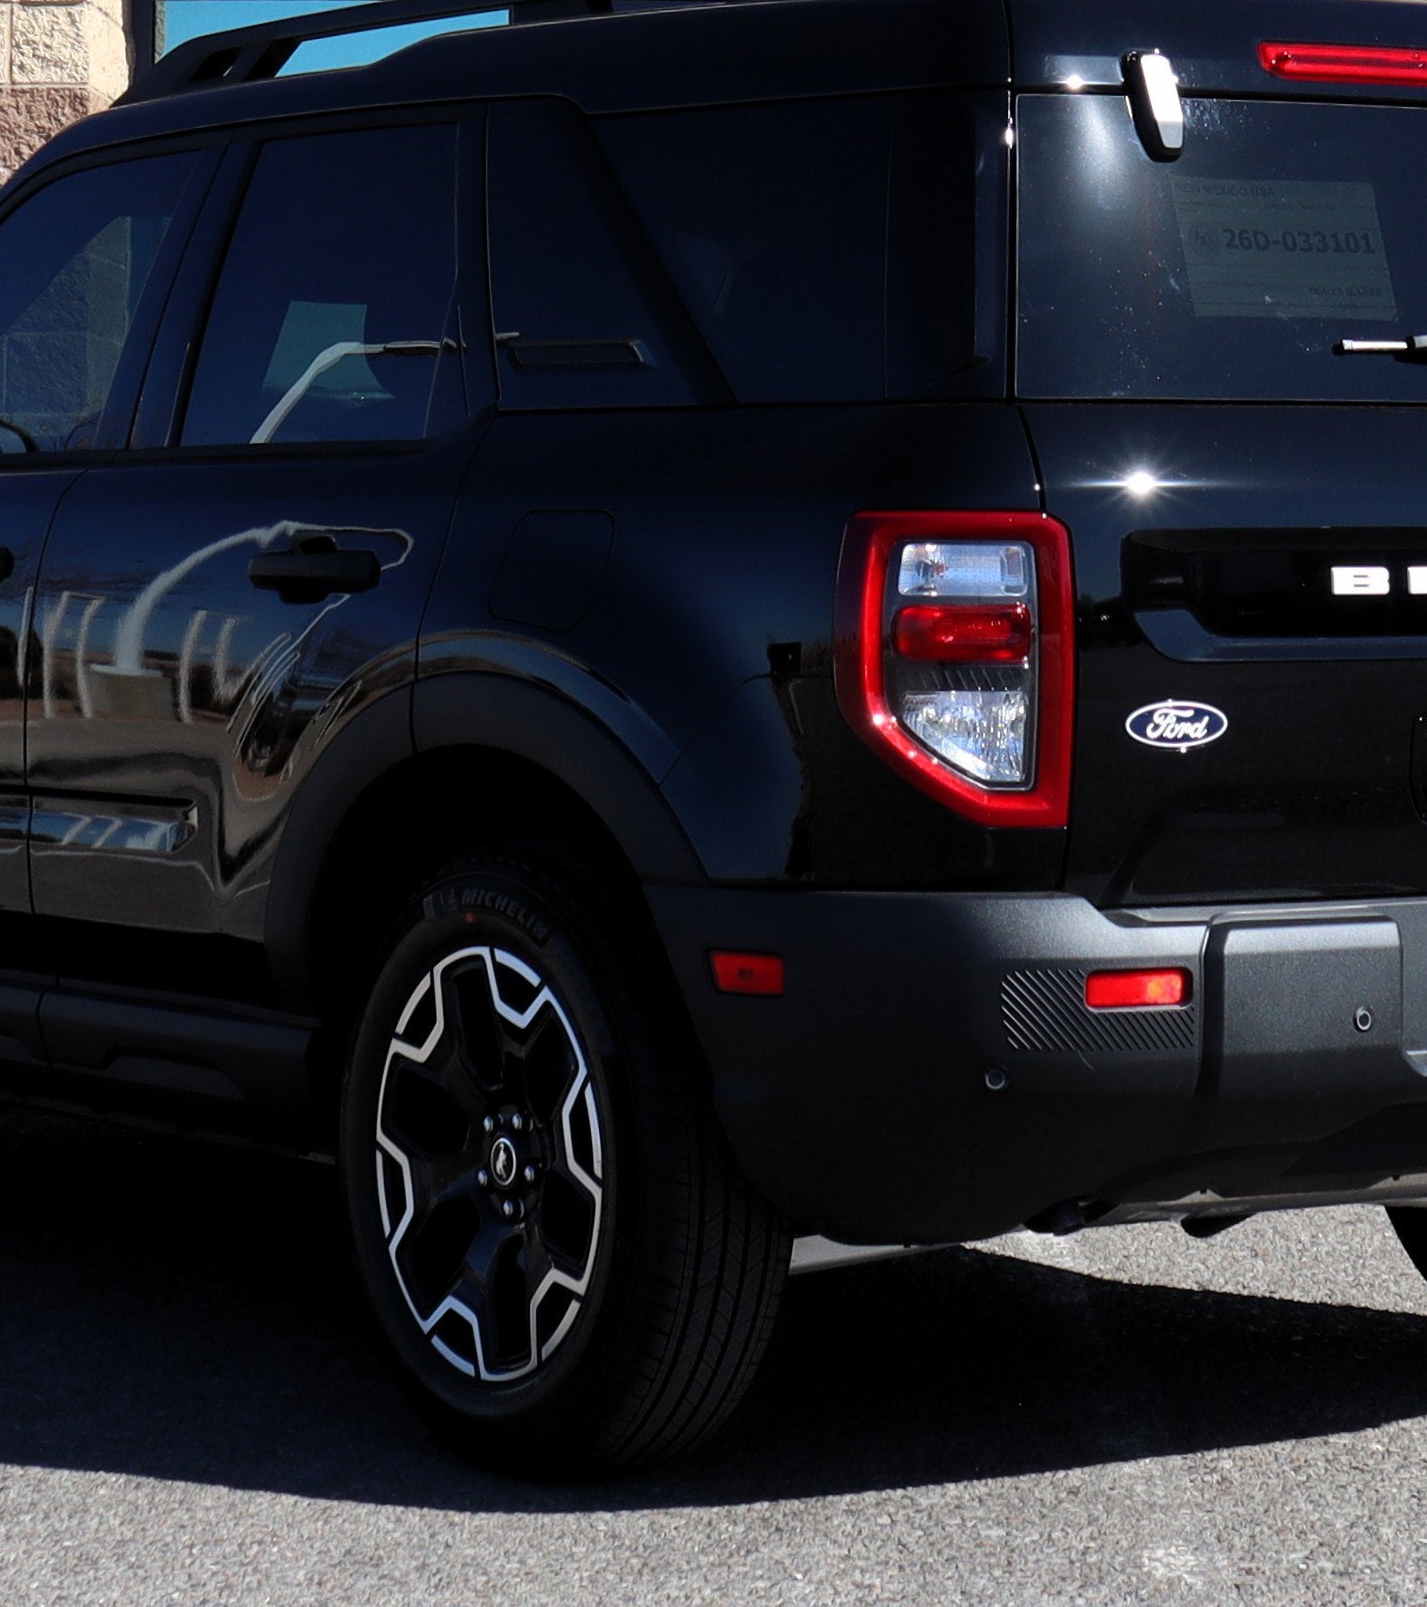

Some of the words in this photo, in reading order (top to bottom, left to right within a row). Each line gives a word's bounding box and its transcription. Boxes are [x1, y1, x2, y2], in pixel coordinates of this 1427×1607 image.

[1223, 227, 1379, 255] 26D-033101
[1146, 708, 1210, 739] Ford
[462, 887, 549, 941] MICHELIN
